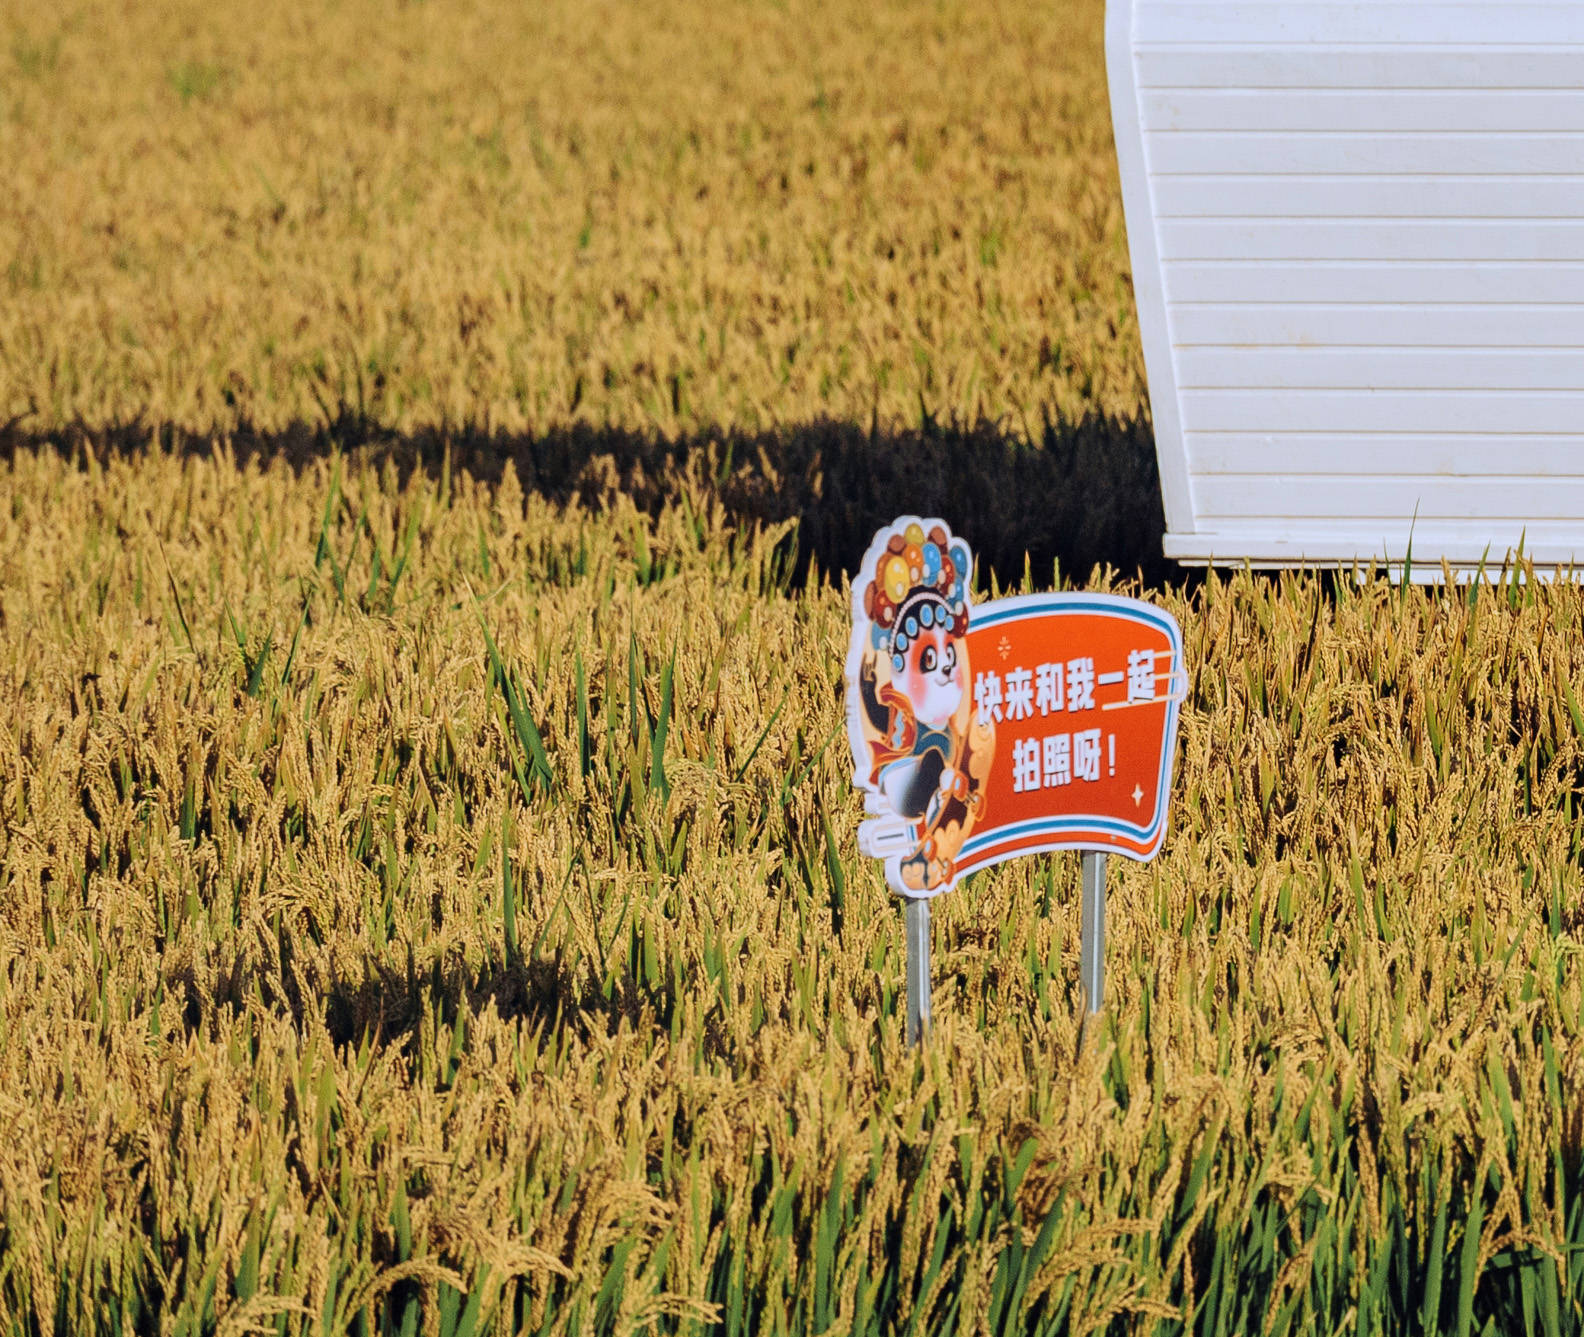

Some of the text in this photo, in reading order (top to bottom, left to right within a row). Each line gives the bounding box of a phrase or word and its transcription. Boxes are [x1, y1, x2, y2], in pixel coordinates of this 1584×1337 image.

[974, 649, 1156, 726] 快来和我一起
[1012, 729, 1116, 793] 拍照呀！
